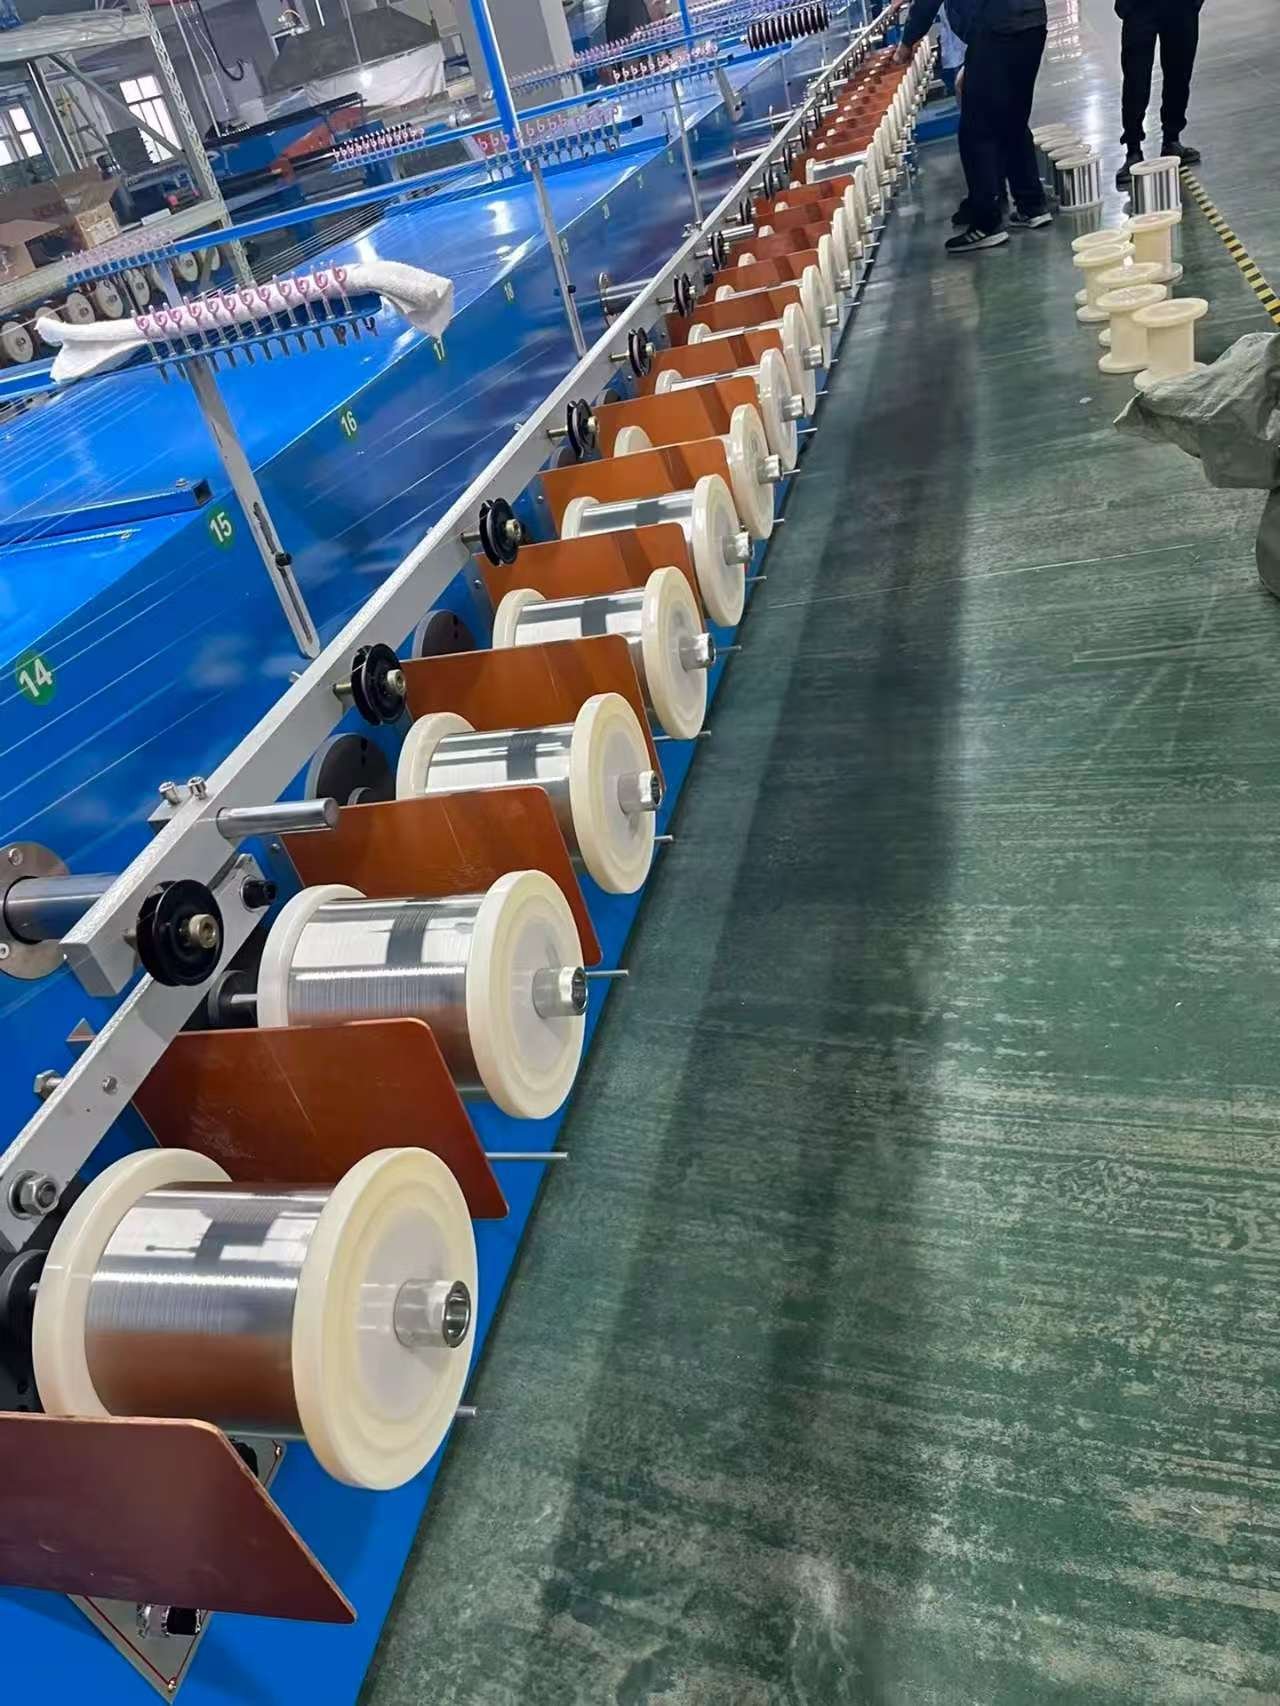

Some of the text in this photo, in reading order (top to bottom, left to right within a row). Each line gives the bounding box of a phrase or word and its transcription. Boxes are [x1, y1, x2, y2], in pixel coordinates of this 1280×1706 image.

[341, 411, 357, 436] 16
[210, 511, 232, 543] 15
[19, 658, 53, 698] 14
